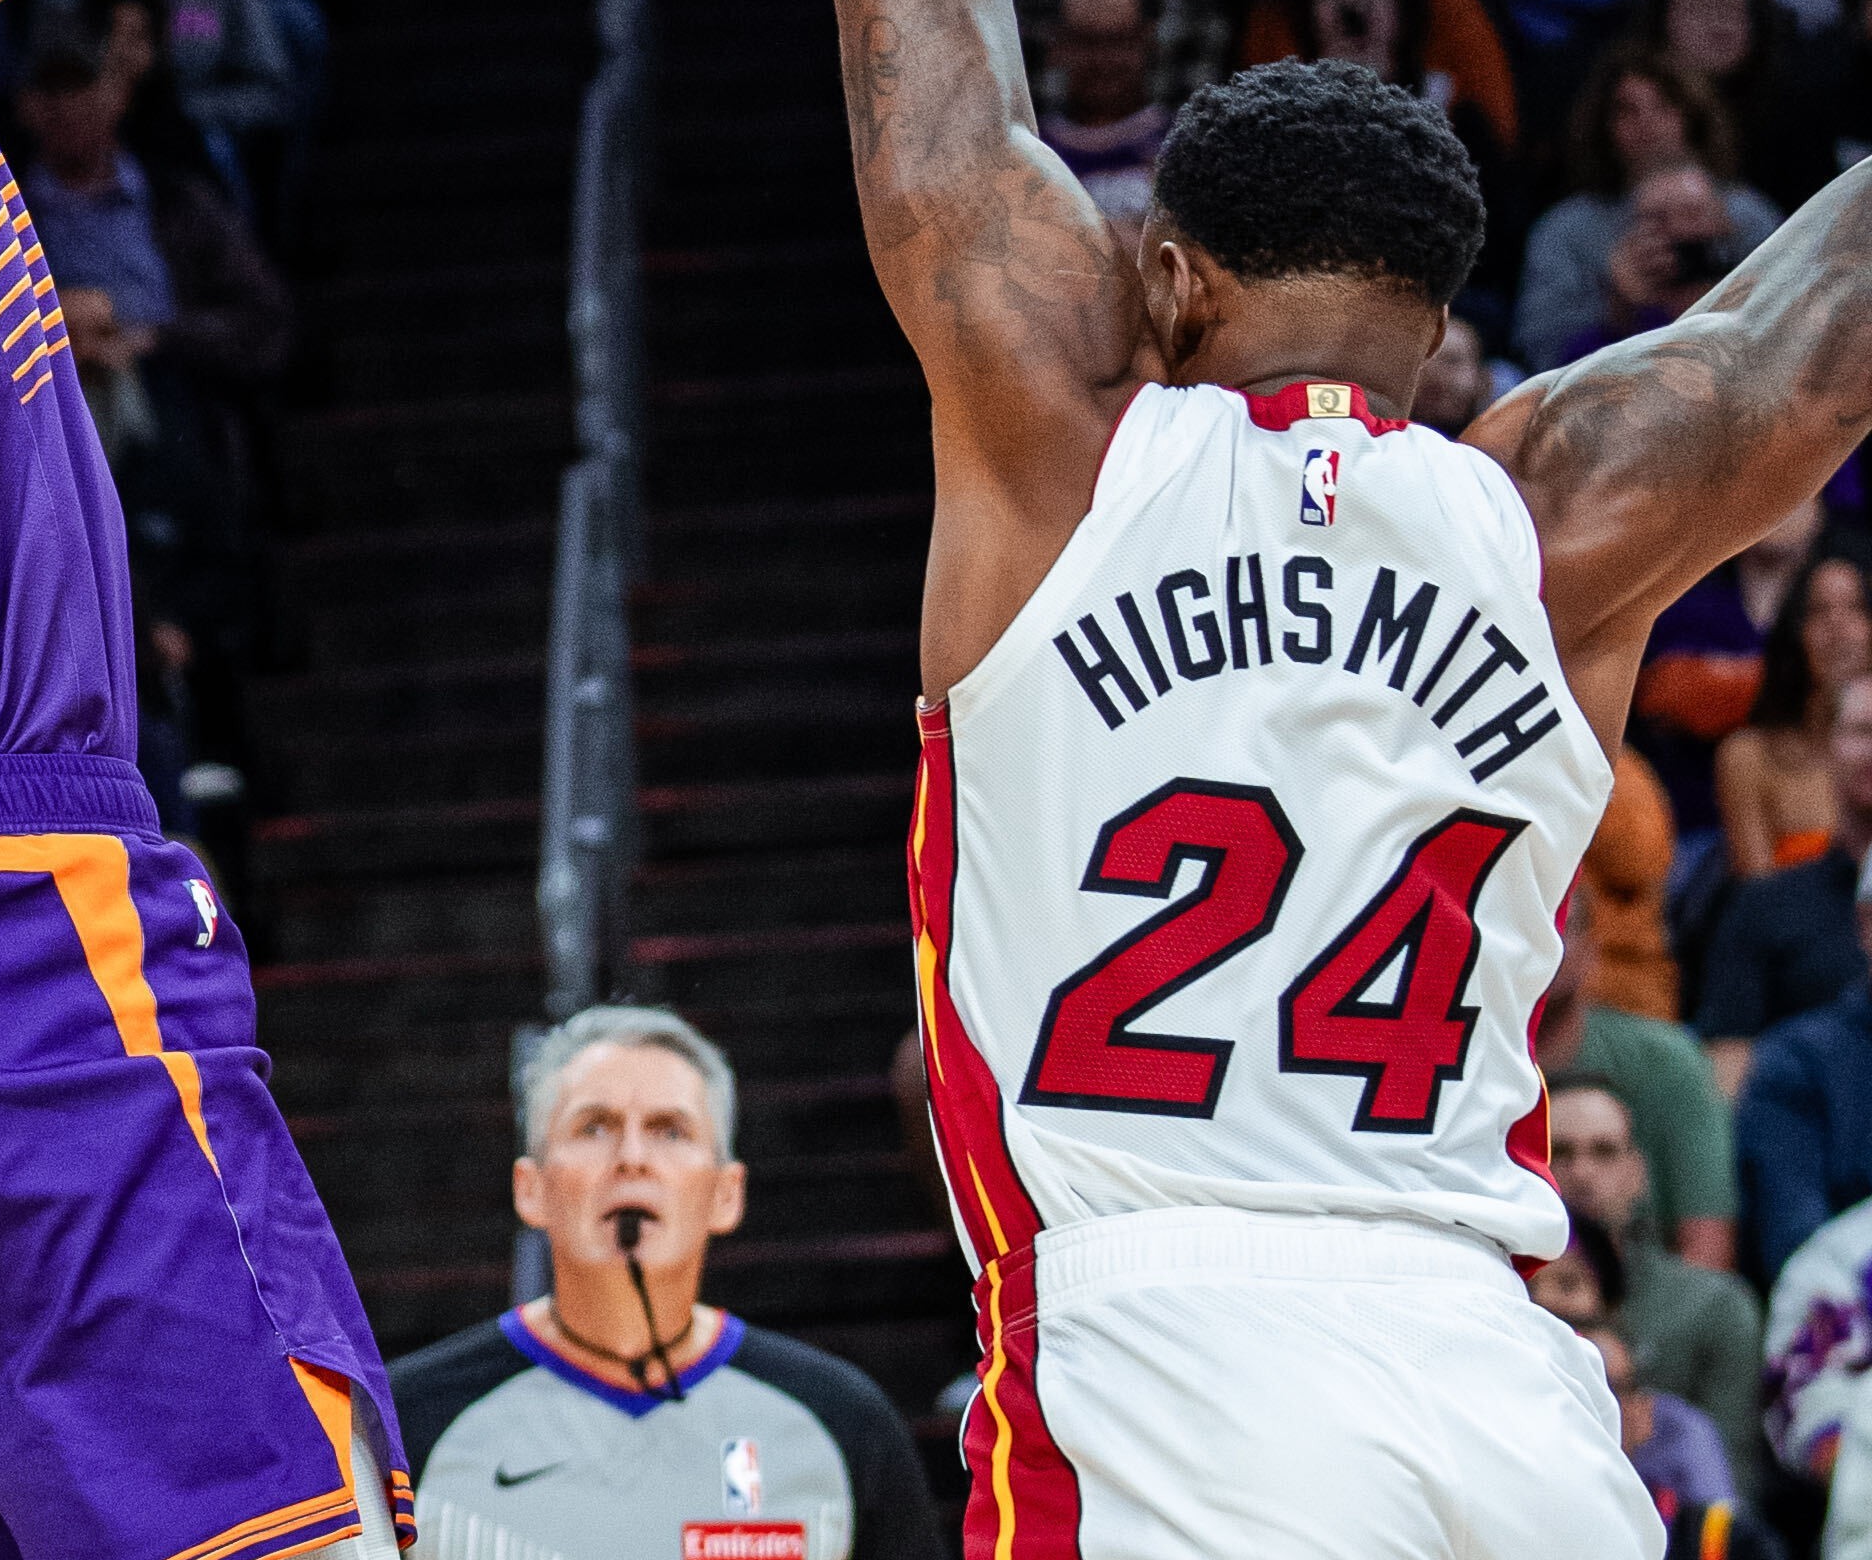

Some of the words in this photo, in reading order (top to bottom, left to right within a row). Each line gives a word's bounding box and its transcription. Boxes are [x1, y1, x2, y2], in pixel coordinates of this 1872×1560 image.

[1052, 552, 1562, 784] HIGHSMITH
[1018, 776, 1532, 1135] 24
[685, 1528, 803, 1559] Emirates
